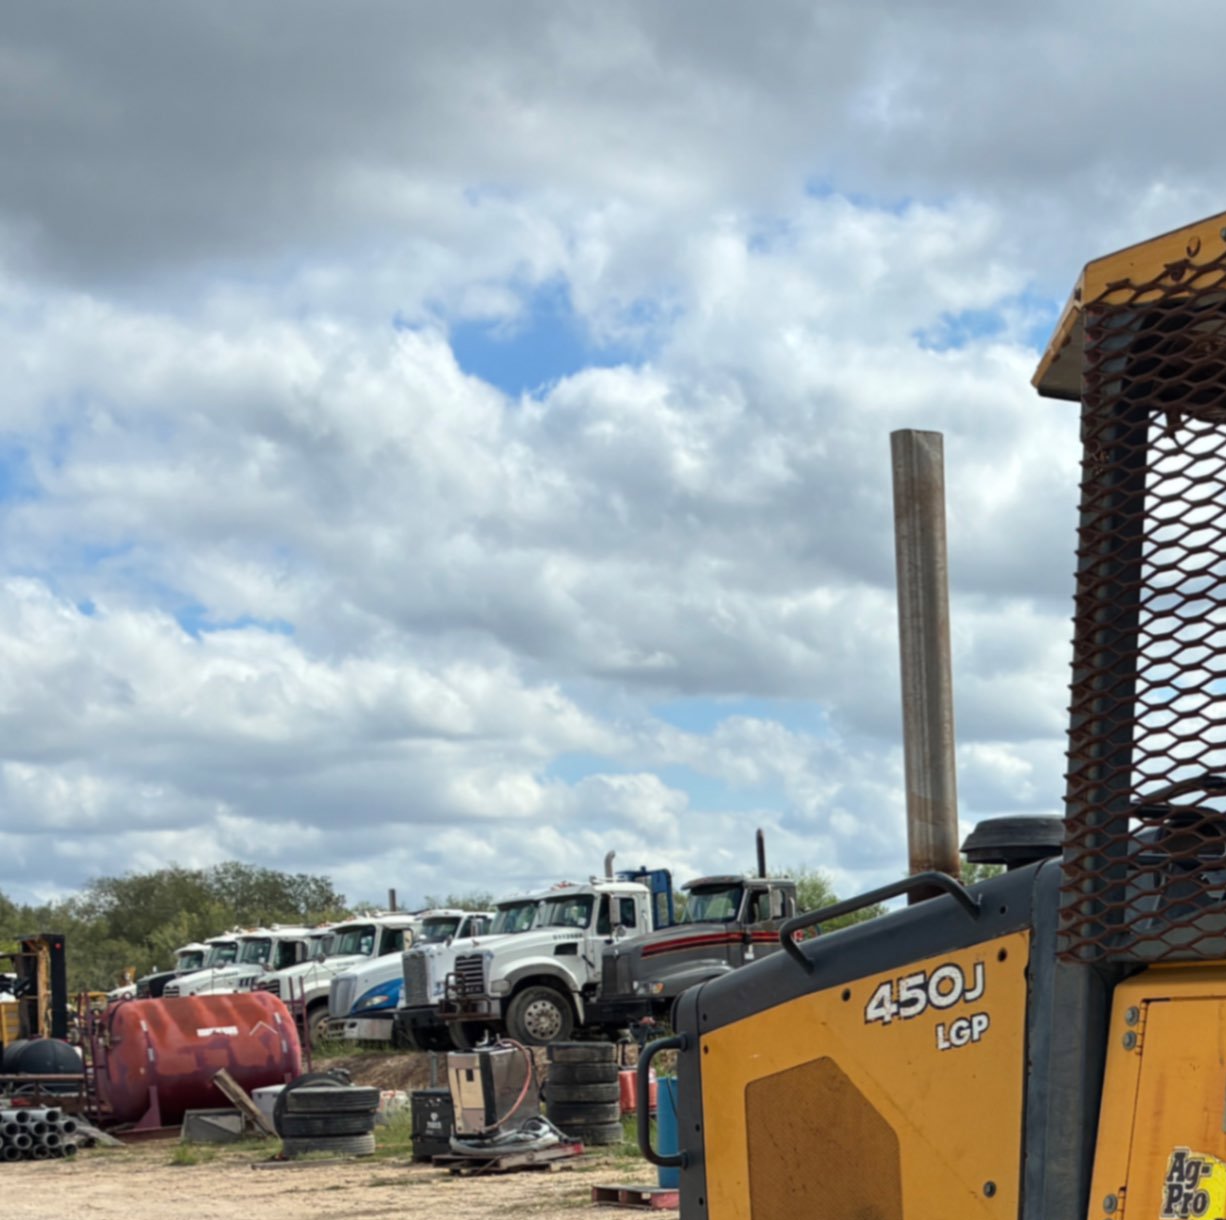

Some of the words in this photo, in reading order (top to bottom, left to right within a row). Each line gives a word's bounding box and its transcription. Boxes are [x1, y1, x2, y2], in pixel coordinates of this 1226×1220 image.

[864, 961, 985, 1025] 450J
[936, 1012, 990, 1050] LGP
[1166, 1151, 1211, 1190] Ag-
[1163, 1183, 1209, 1216] Pro
